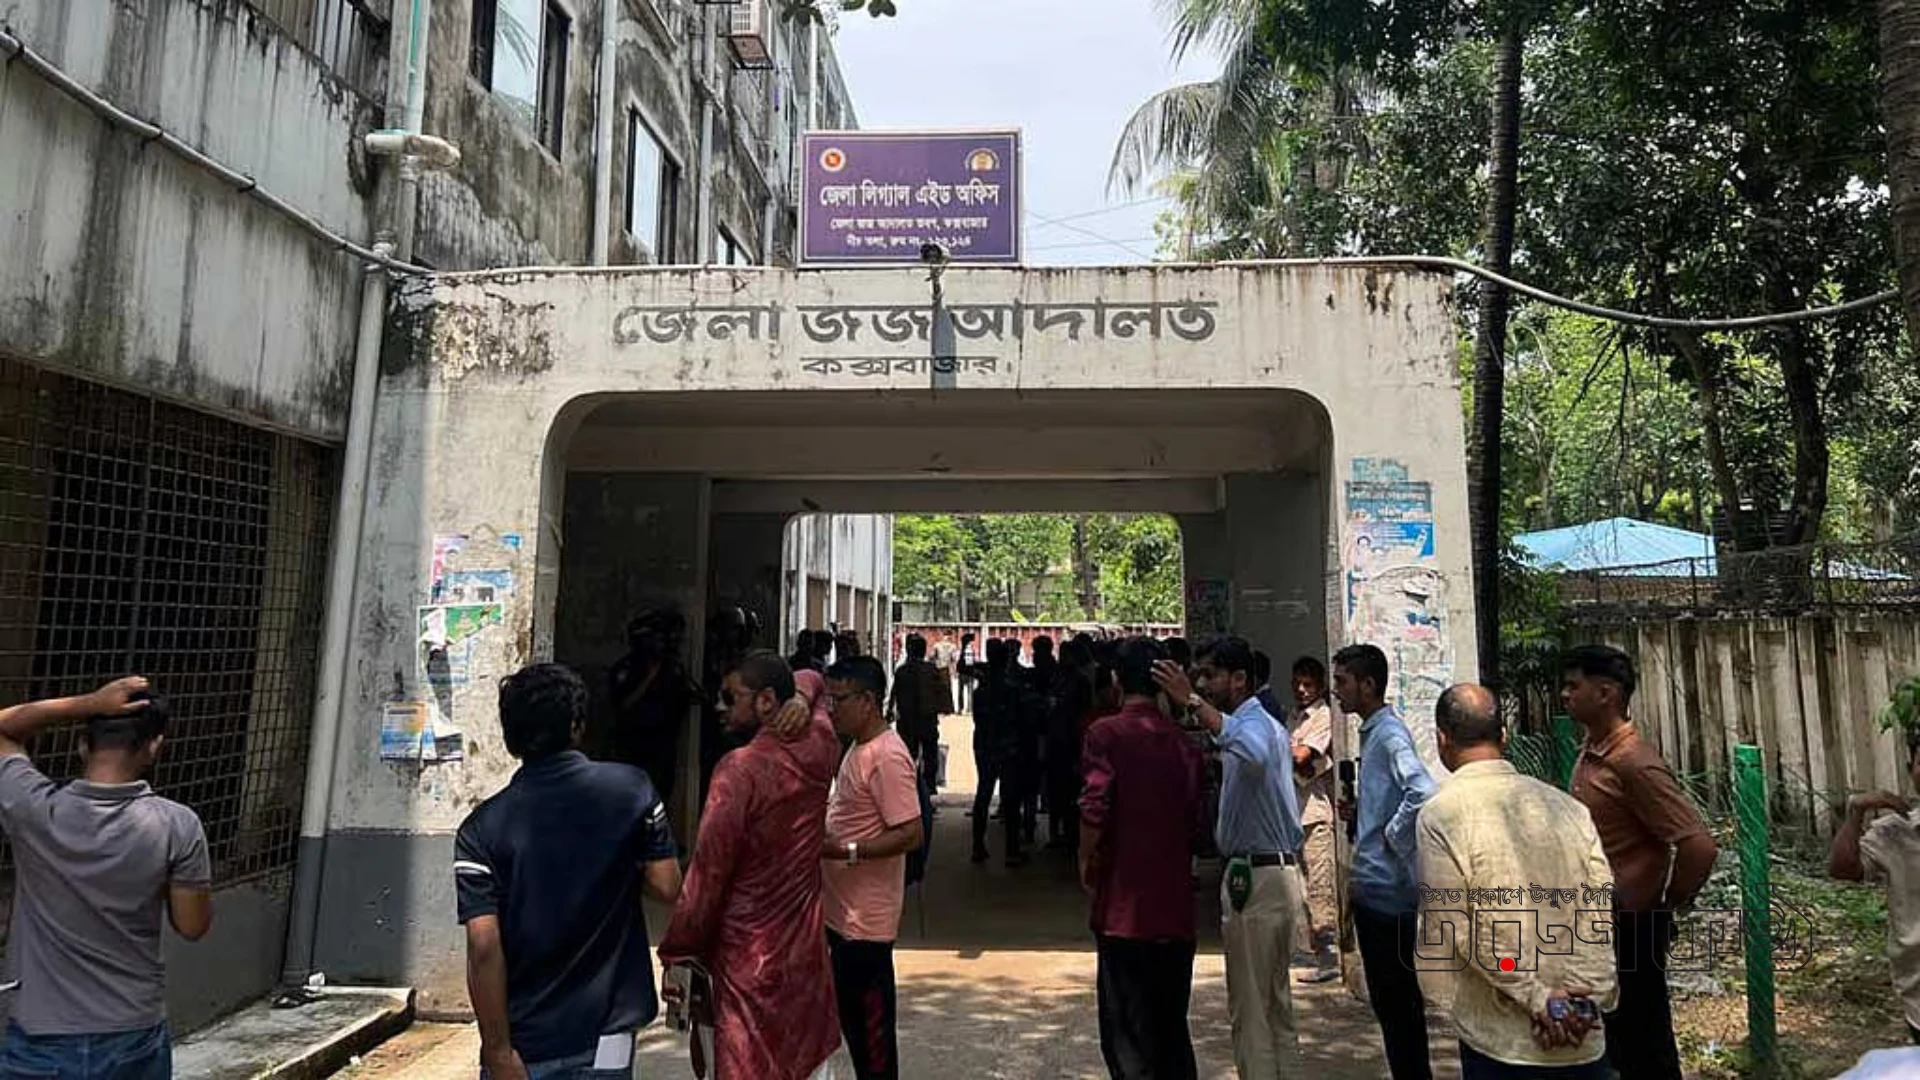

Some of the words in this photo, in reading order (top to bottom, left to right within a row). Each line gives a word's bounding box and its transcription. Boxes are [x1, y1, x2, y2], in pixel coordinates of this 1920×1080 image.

[820, 183, 857, 207] জেলা
[862, 179, 910, 207] লিগ্যাল
[915, 178, 951, 209] এইড
[955, 178, 1000, 207] অফিস
[613, 299, 783, 343] জেলা
[796, 302, 932, 343] জজ
[945, 298, 1218, 342] আদালত
